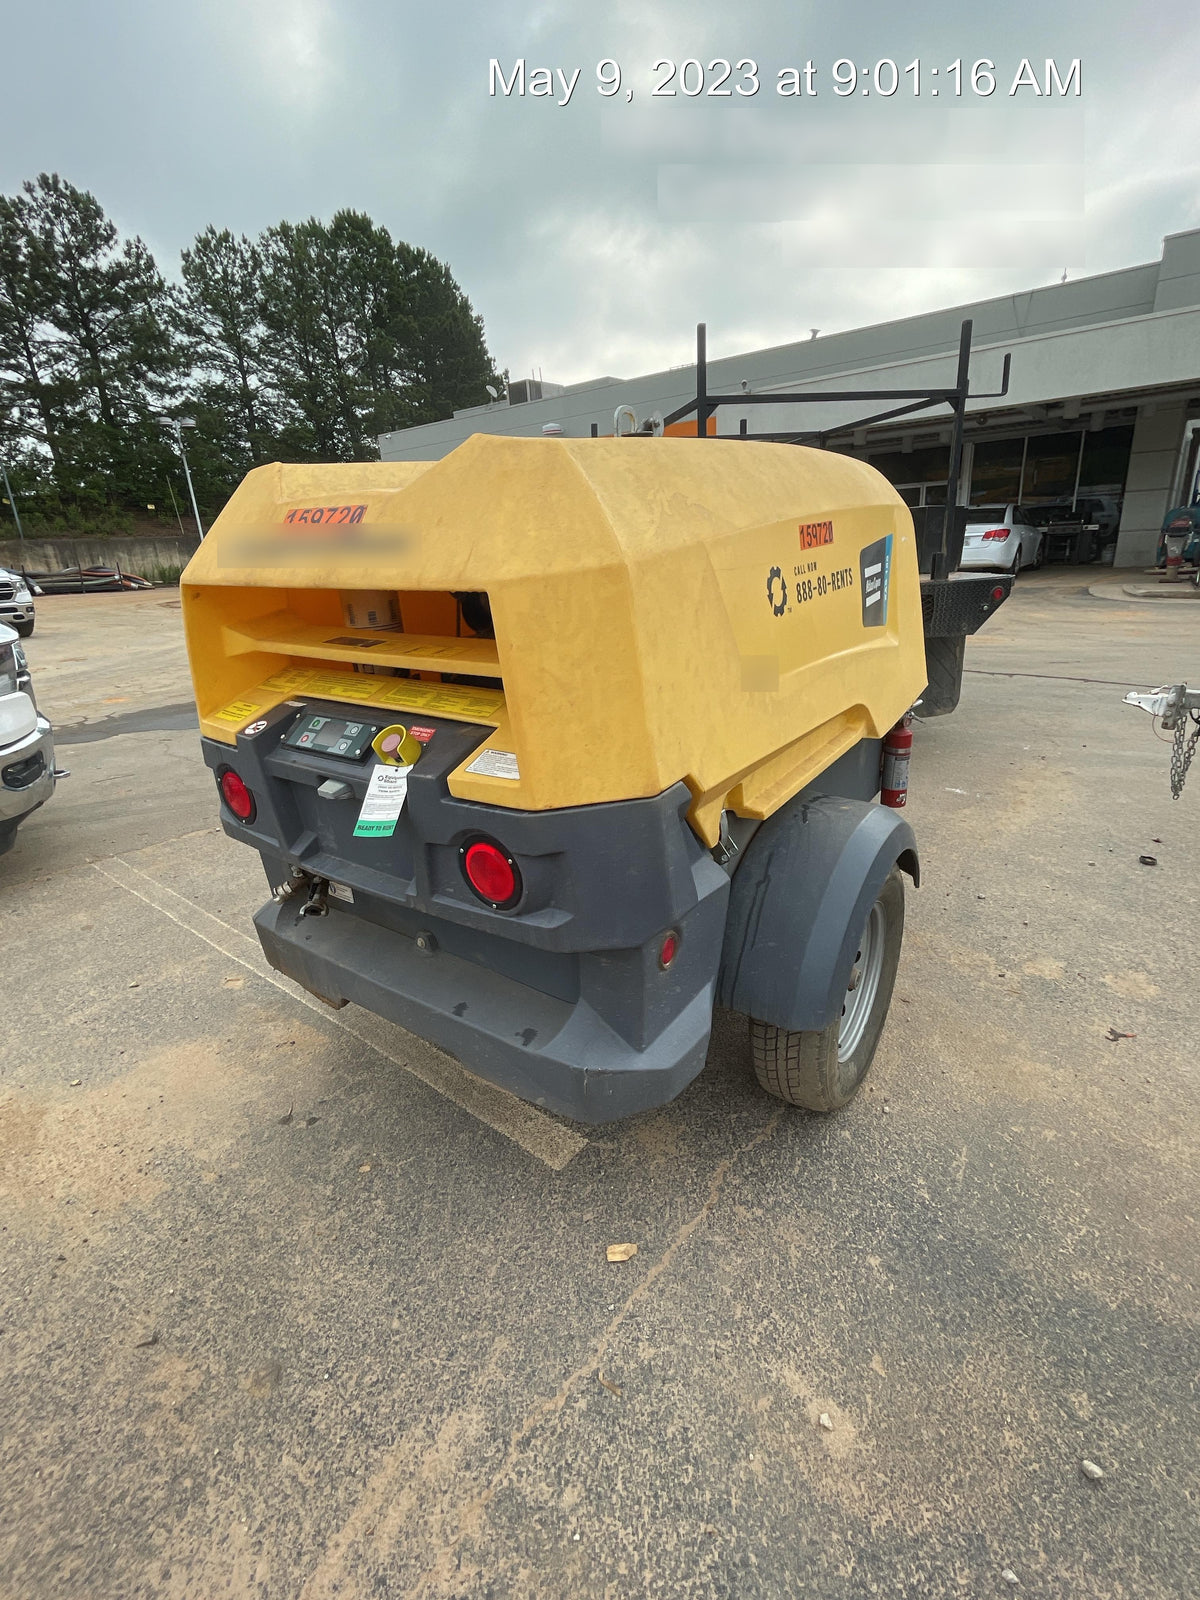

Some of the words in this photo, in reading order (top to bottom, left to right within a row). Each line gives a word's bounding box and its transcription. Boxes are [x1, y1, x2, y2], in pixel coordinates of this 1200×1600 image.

[800, 521, 834, 548] 159720
[794, 564, 806, 576] CALL
[807, 561, 817, 573] NOW
[796, 567, 853, 604] 888-80-RENTS
